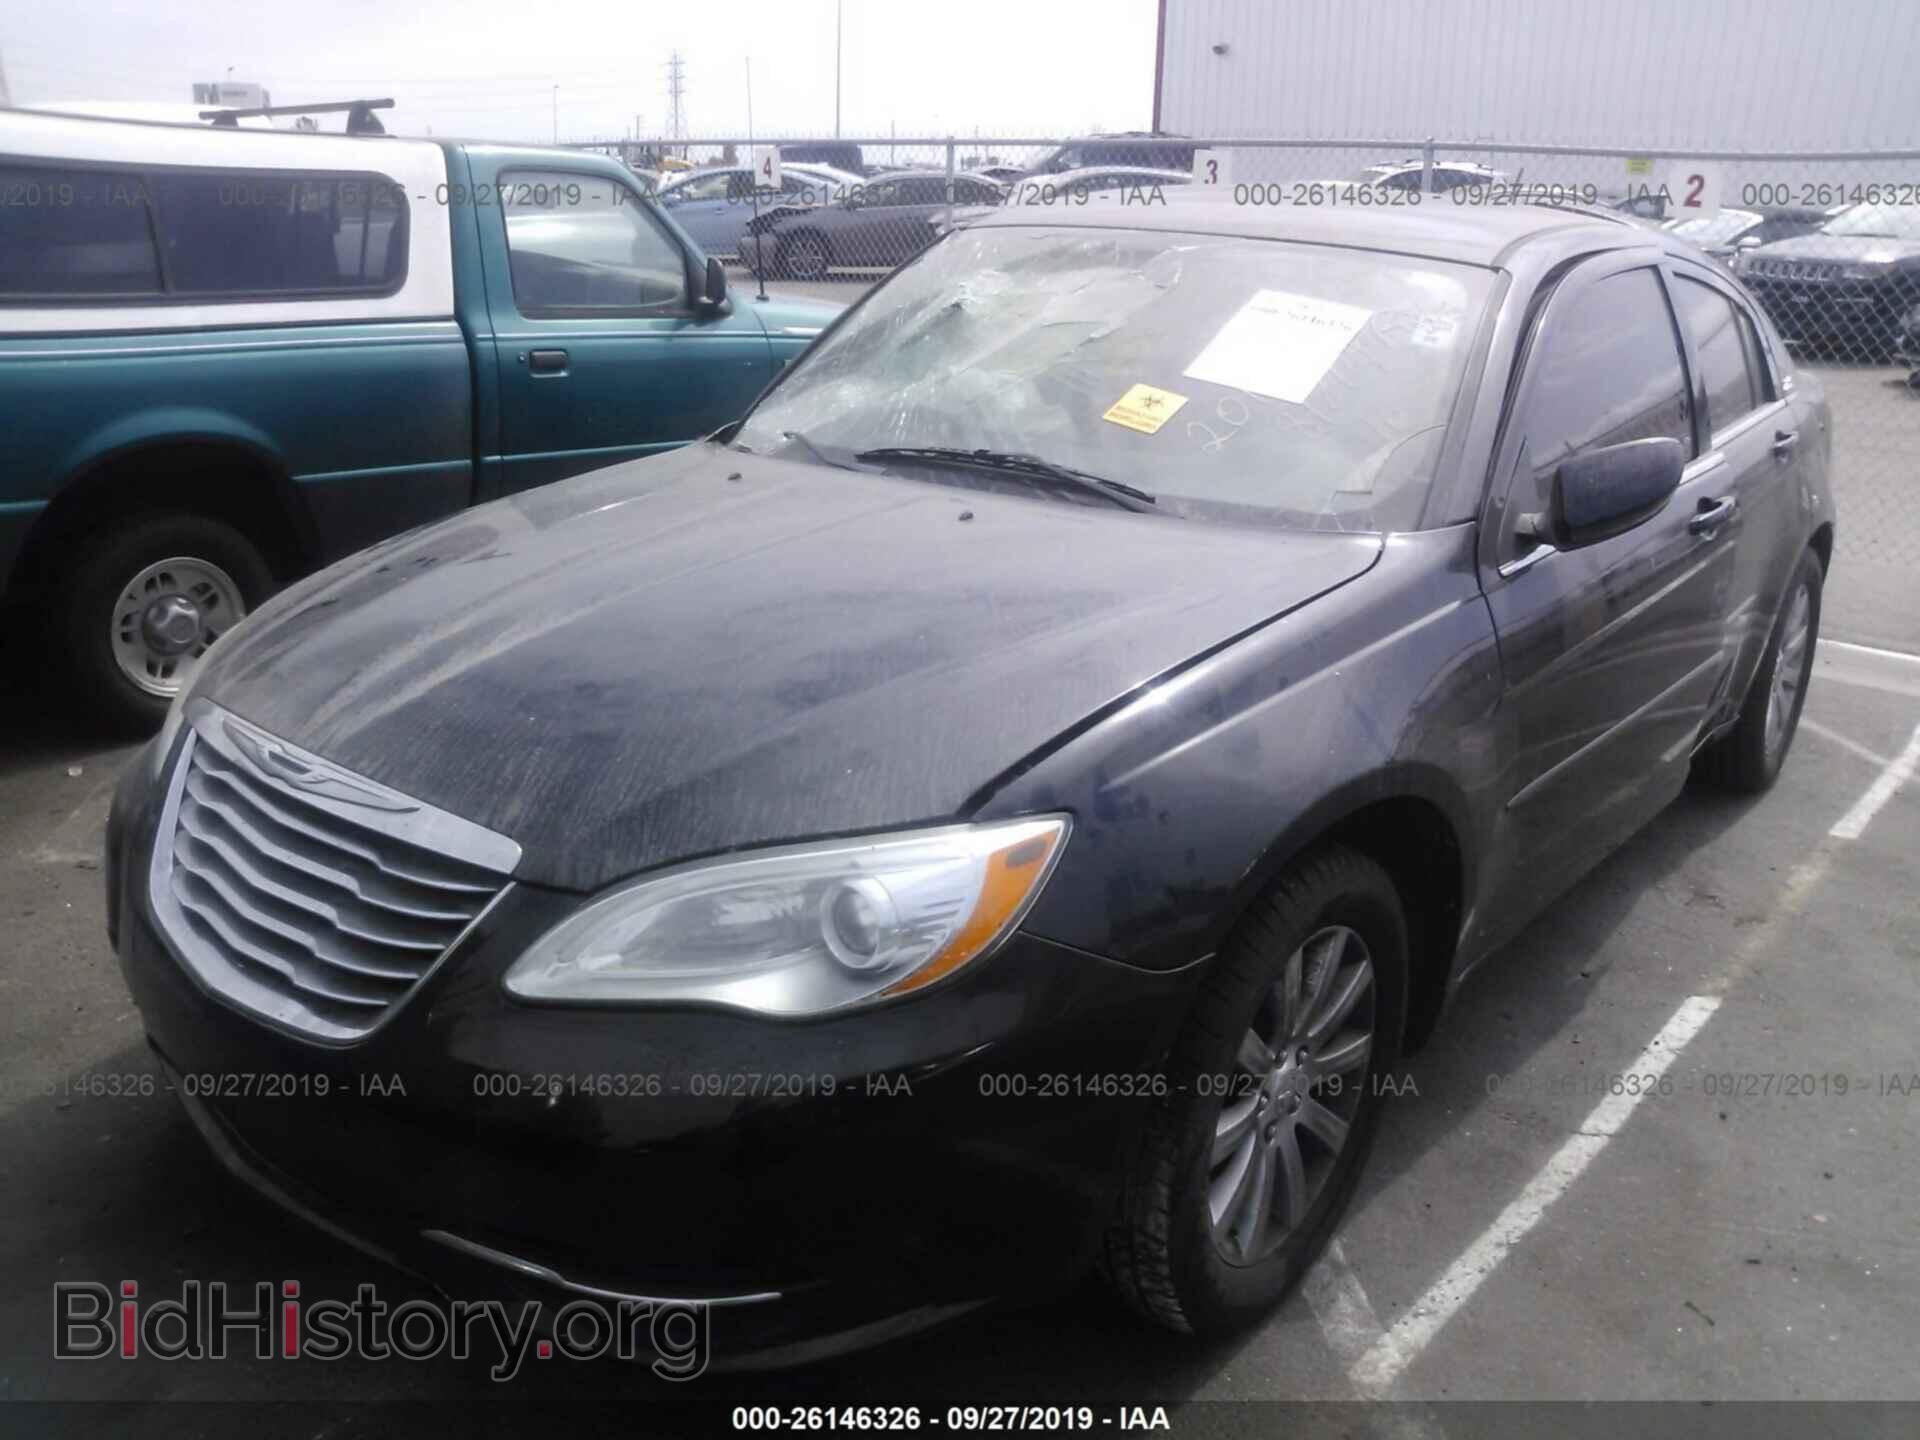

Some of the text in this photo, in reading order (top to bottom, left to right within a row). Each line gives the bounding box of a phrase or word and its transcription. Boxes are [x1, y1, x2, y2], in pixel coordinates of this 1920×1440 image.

[762, 156, 773, 179] 4
[1204, 159, 1218, 185] 3
[1683, 174, 1705, 208] 2
